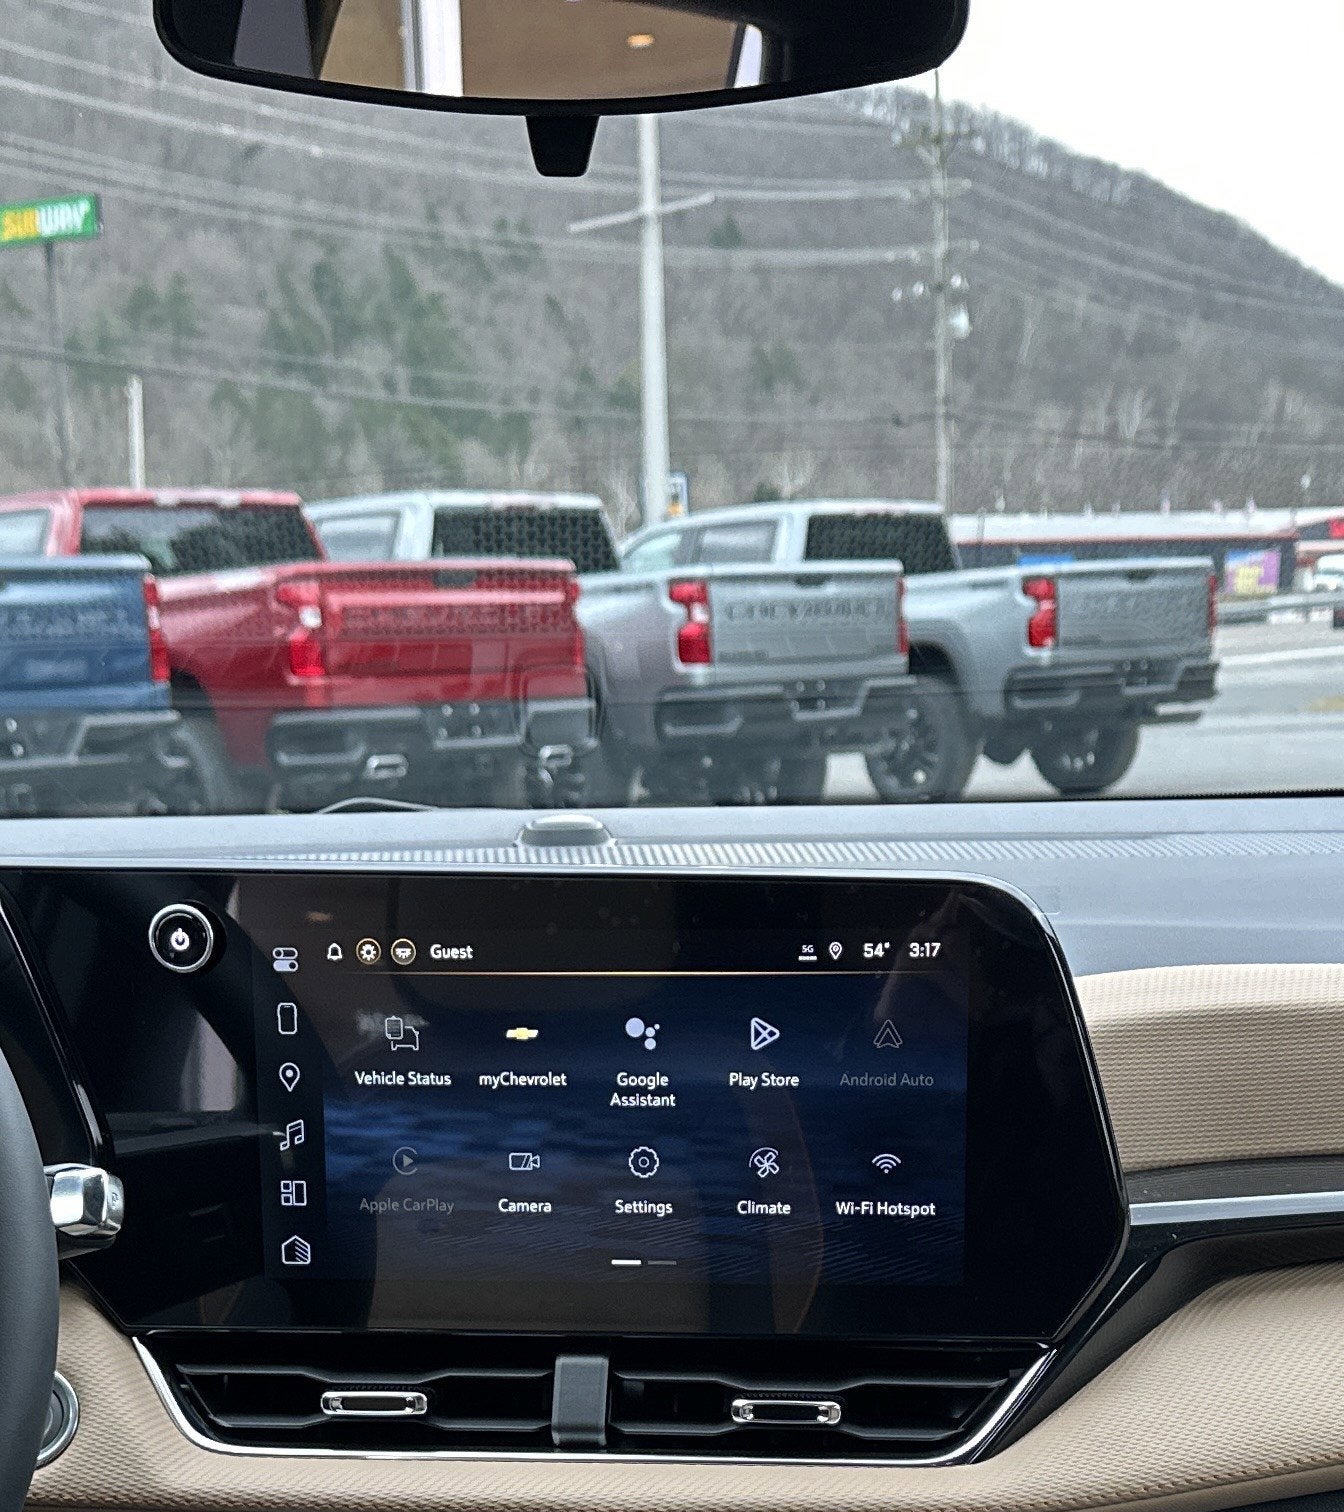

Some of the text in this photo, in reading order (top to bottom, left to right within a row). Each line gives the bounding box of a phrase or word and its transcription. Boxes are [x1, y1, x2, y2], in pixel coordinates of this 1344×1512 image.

[430, 943, 474, 960] Guest
[909, 942, 942, 958] 3:17
[355, 1070, 452, 1086] Vehicle Status
[478, 1072, 567, 1090] myChevrolet
[616, 1072, 669, 1090] Google
[729, 1072, 800, 1090] Play Store
[839, 1072, 935, 1088] Android Auto
[610, 1092, 676, 1108] Assistant
[359, 1198, 455, 1214] Apple CarPlay
[498, 1199, 552, 1213] Camera
[614, 1200, 673, 1217] Settings
[737, 1200, 791, 1215] Climate
[835, 1201, 936, 1218] Wi-Fi Hotspot
